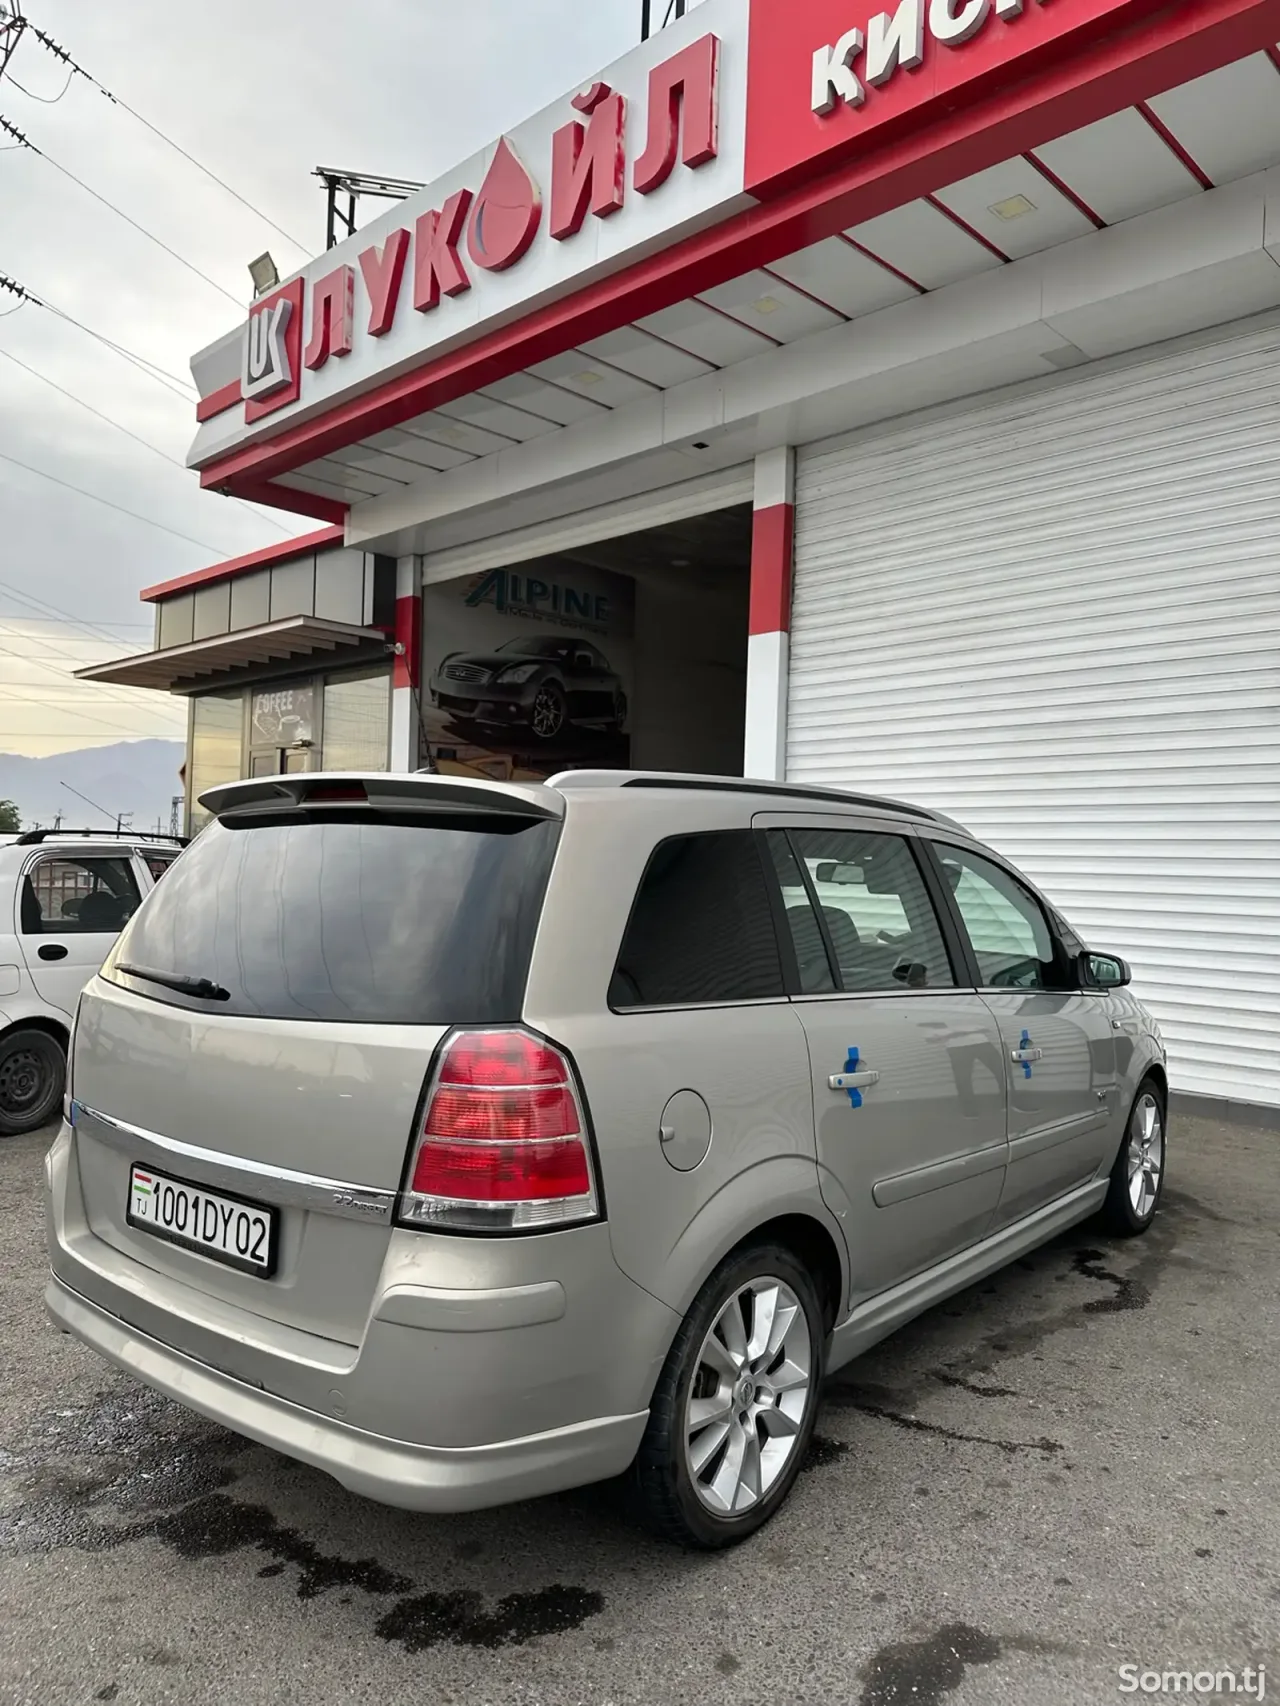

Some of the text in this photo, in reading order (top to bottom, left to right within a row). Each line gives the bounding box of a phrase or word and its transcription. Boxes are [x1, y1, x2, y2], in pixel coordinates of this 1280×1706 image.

[304, 32, 721, 371] ЛУКОЙЛ
[464, 566, 610, 621] ALPINE
[137, 1198, 147, 1215] TJ
[153, 1182, 266, 1262] 1001DY02
